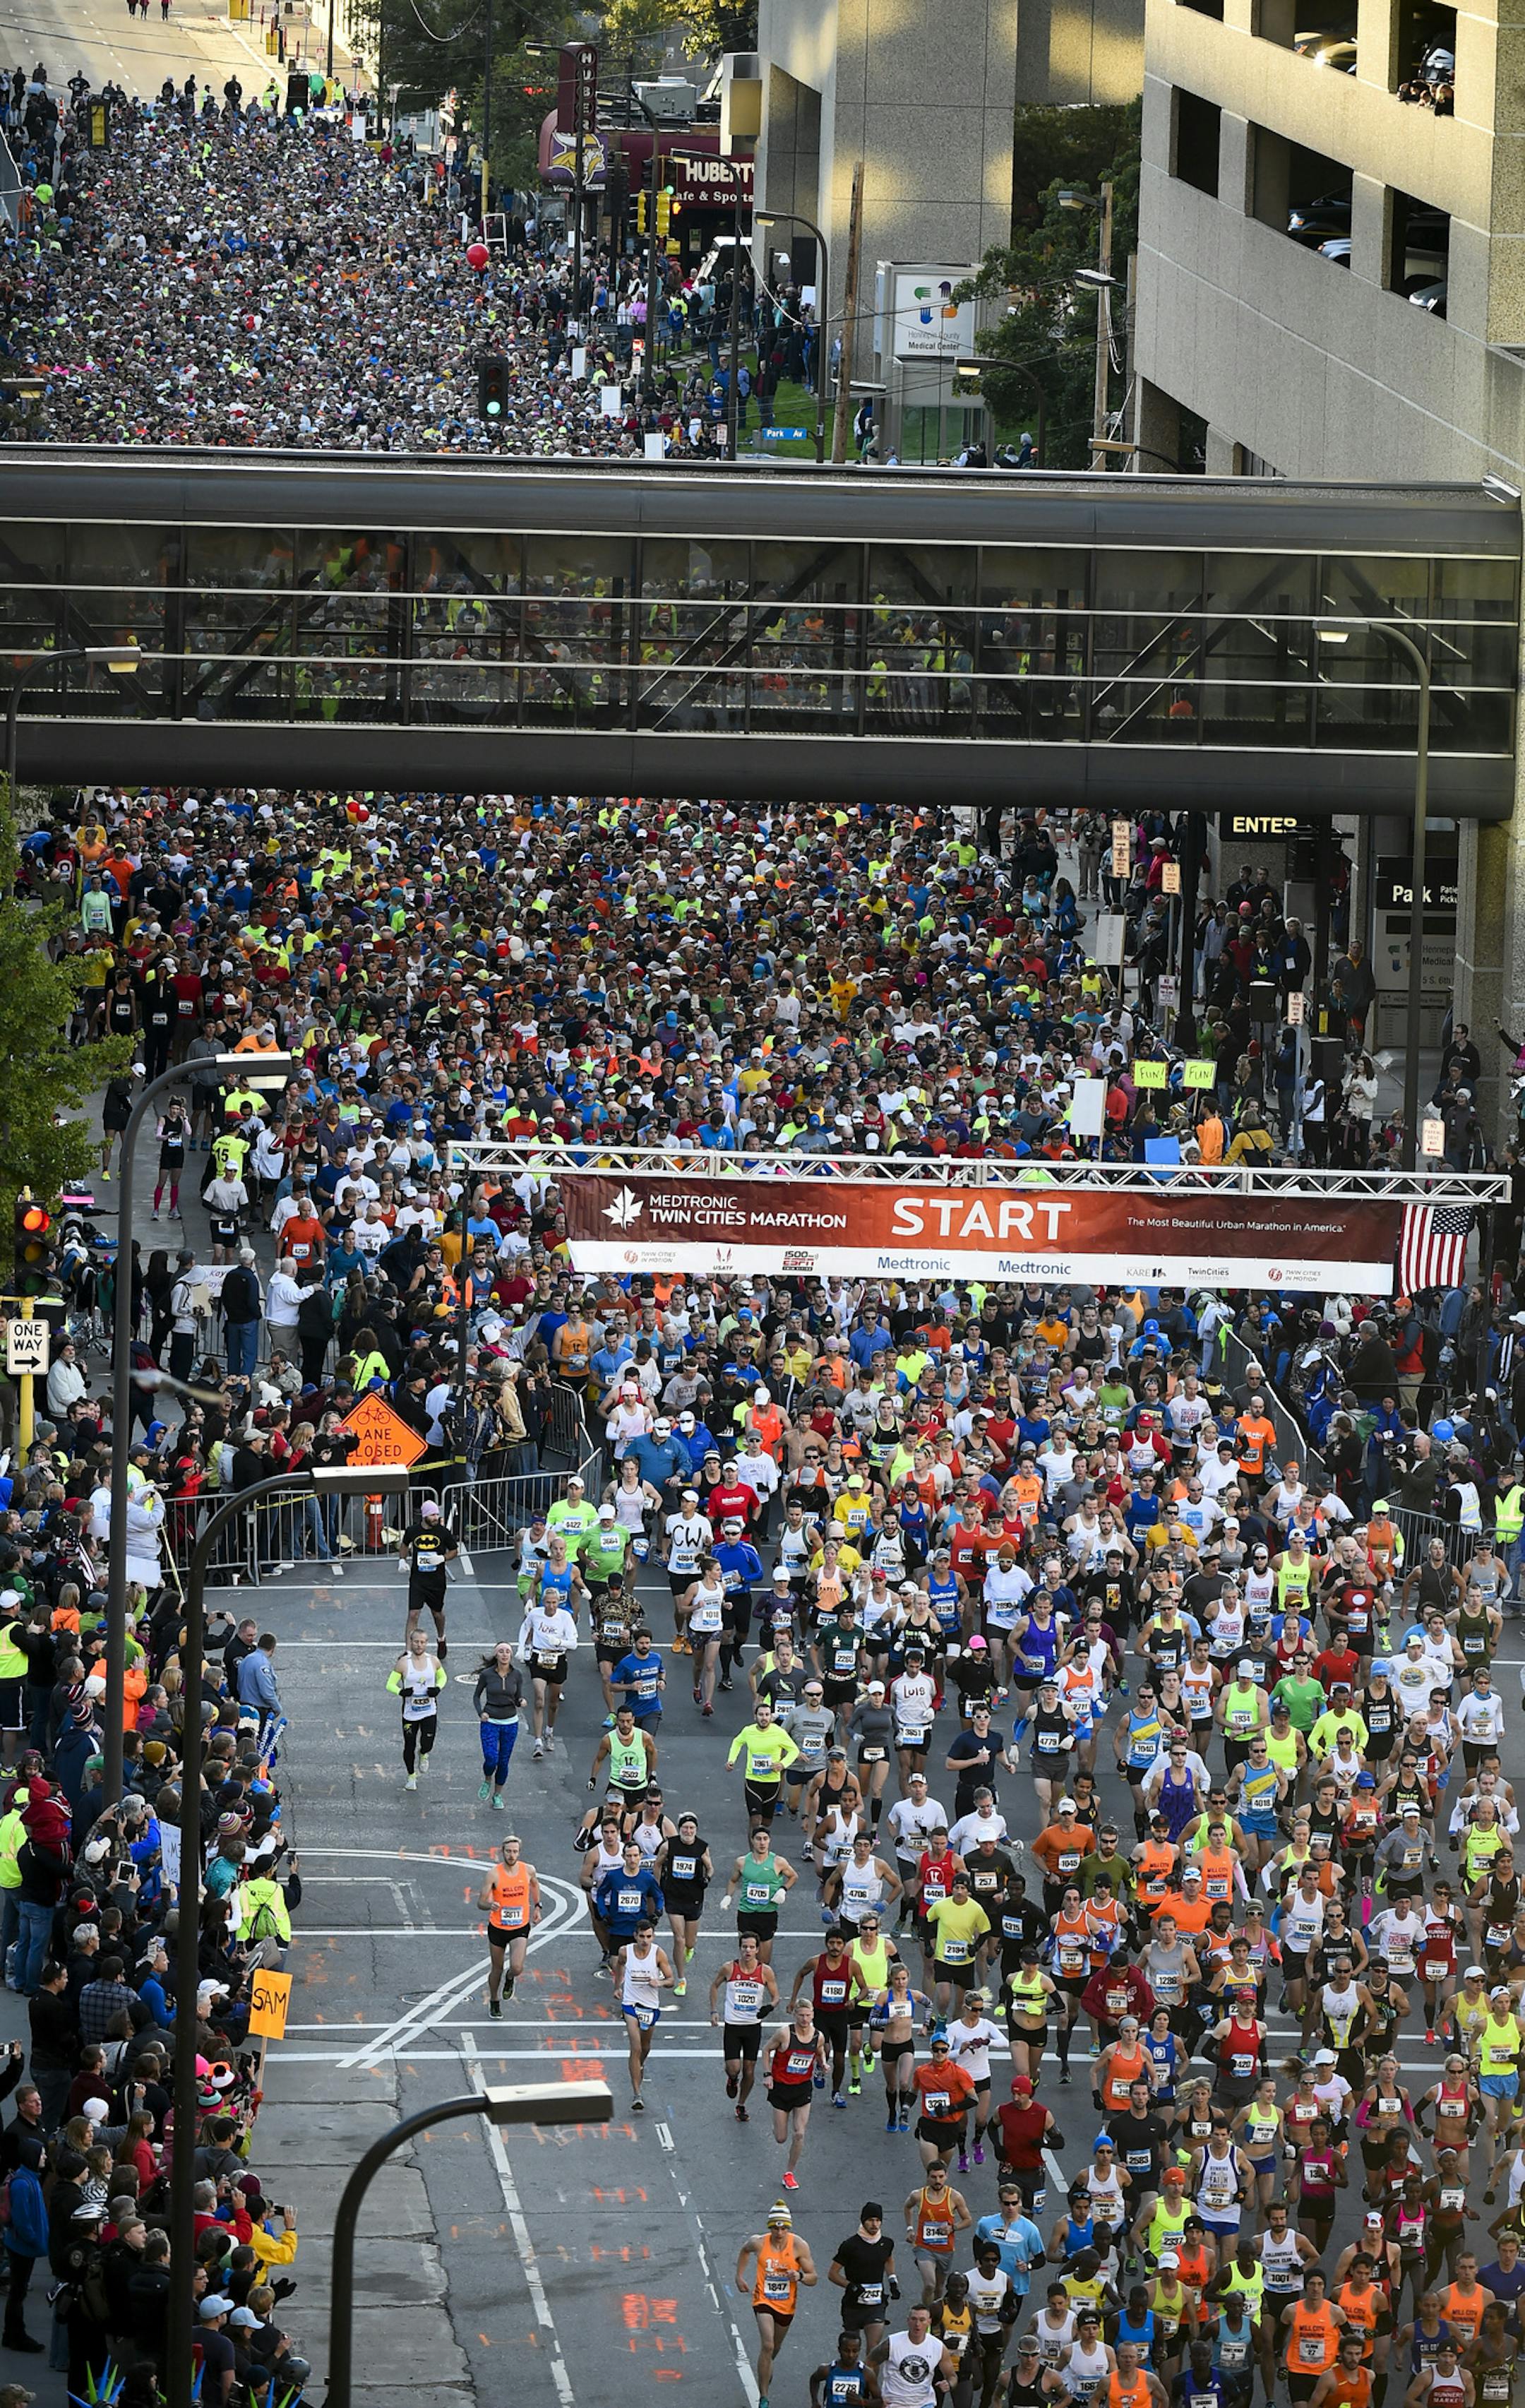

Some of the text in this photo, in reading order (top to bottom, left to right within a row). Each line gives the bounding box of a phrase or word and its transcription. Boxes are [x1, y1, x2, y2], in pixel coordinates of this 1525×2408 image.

[909, 342, 959, 350] Medical Center
[766, 429, 784, 438] Park
[1392, 885, 1432, 902] Pak
[216, 1148, 228, 1162] 15
[650, 1194, 737, 1210] MEDTRONIC
[649, 1209, 846, 1228] TWIN CITIES MARATHON
[891, 1196, 1072, 1241] START
[1127, 1217, 1144, 1227] The
[1147, 1218, 1168, 1227] Most
[1172, 1218, 1214, 1229] Beautiful
[1216, 1220, 1244, 1230] Urban
[1247, 1221, 1290, 1232] Marathon
[1293, 1222, 1301, 1232] in
[878, 1256, 950, 1270] Medtronic
[998, 1260, 1071, 1275] Medtronic
[1127, 1268, 1150, 1277] KARE
[1188, 1268, 1228, 1277] TwinCities
[14, 1323, 42, 1336] ONE
[13, 1339, 42, 1352] WAY
[672, 1525, 702, 1547] CW
[253, 1988, 287, 2022] SAM
[738, 1995, 755, 2004] 1020
